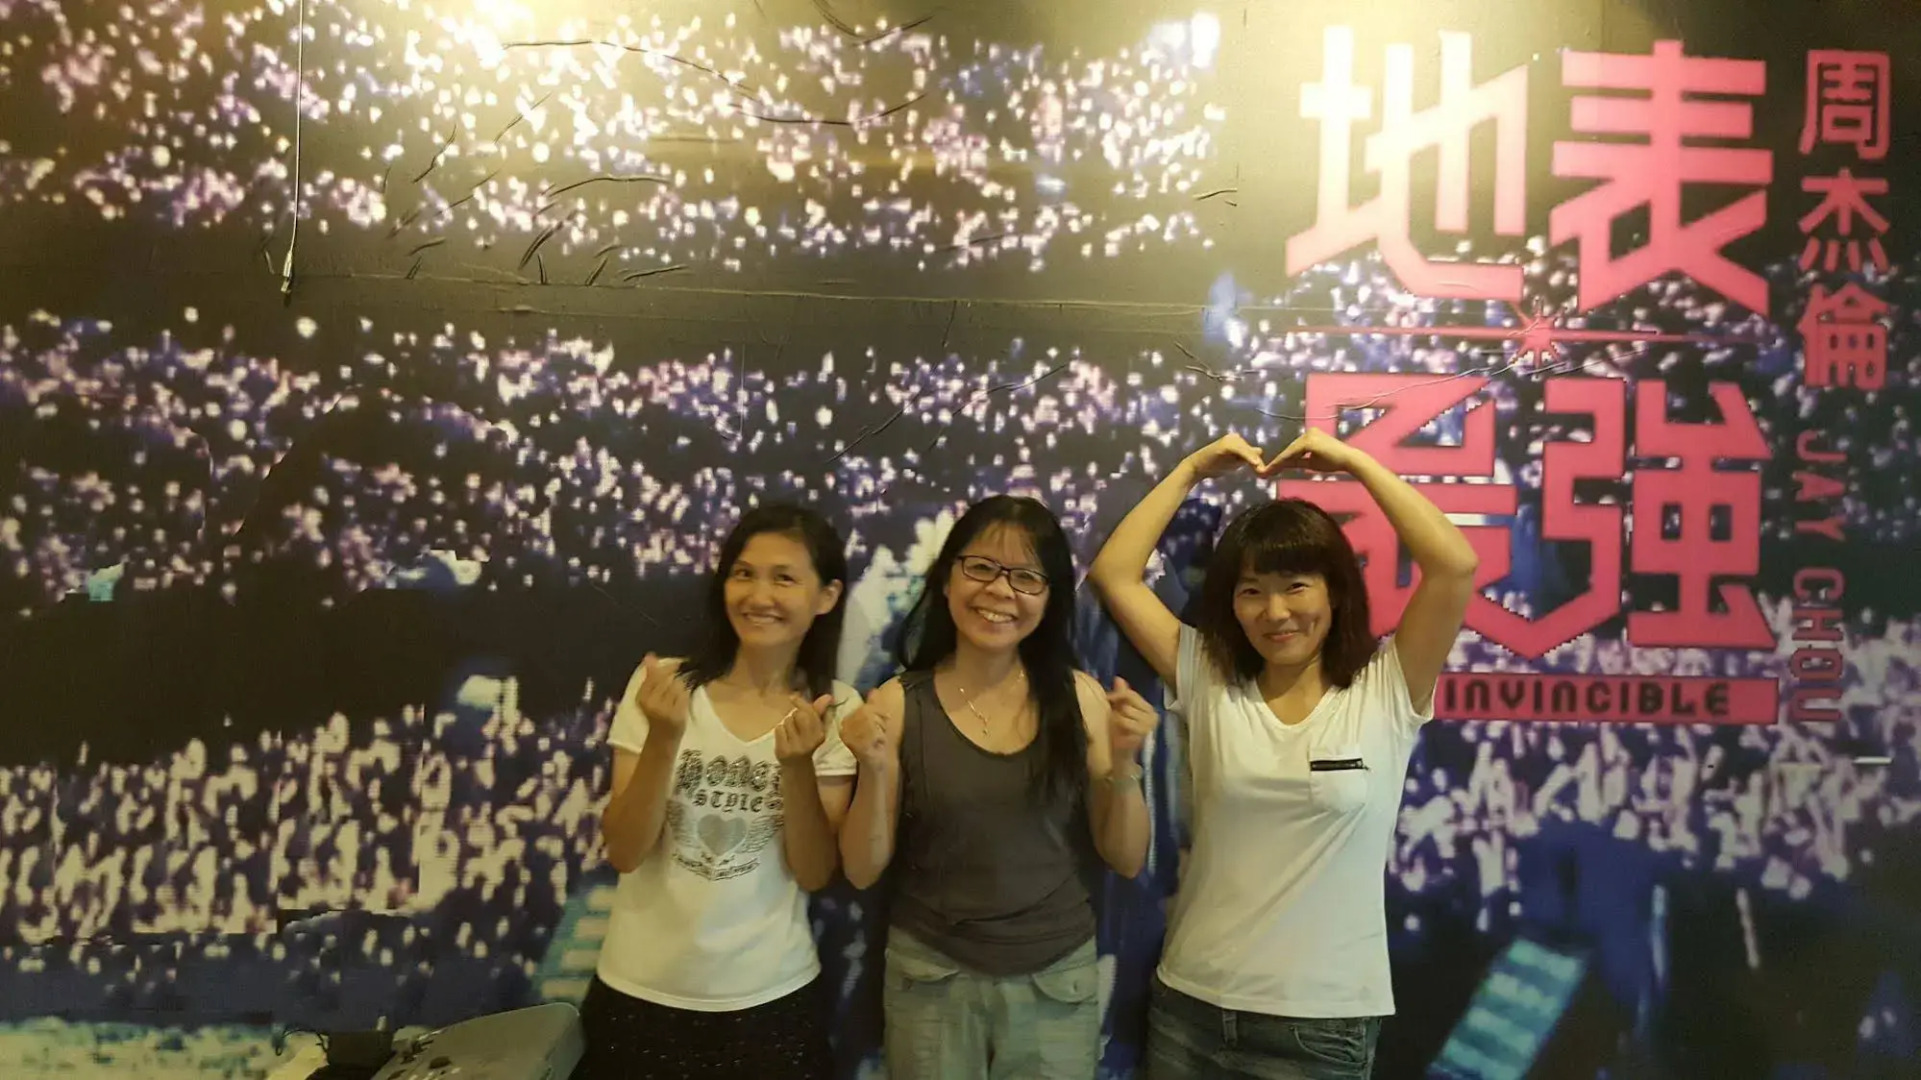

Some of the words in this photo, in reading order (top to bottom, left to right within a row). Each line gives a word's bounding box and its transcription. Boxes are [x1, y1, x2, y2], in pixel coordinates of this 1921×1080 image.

[1286, 25, 1773, 317] 地表
[1799, 49, 1890, 392] 周杰倫
[1792, 430, 1848, 541] JAY
[1443, 677, 1731, 717] INVINCIBLE
[1788, 567, 1845, 722] CHOU
